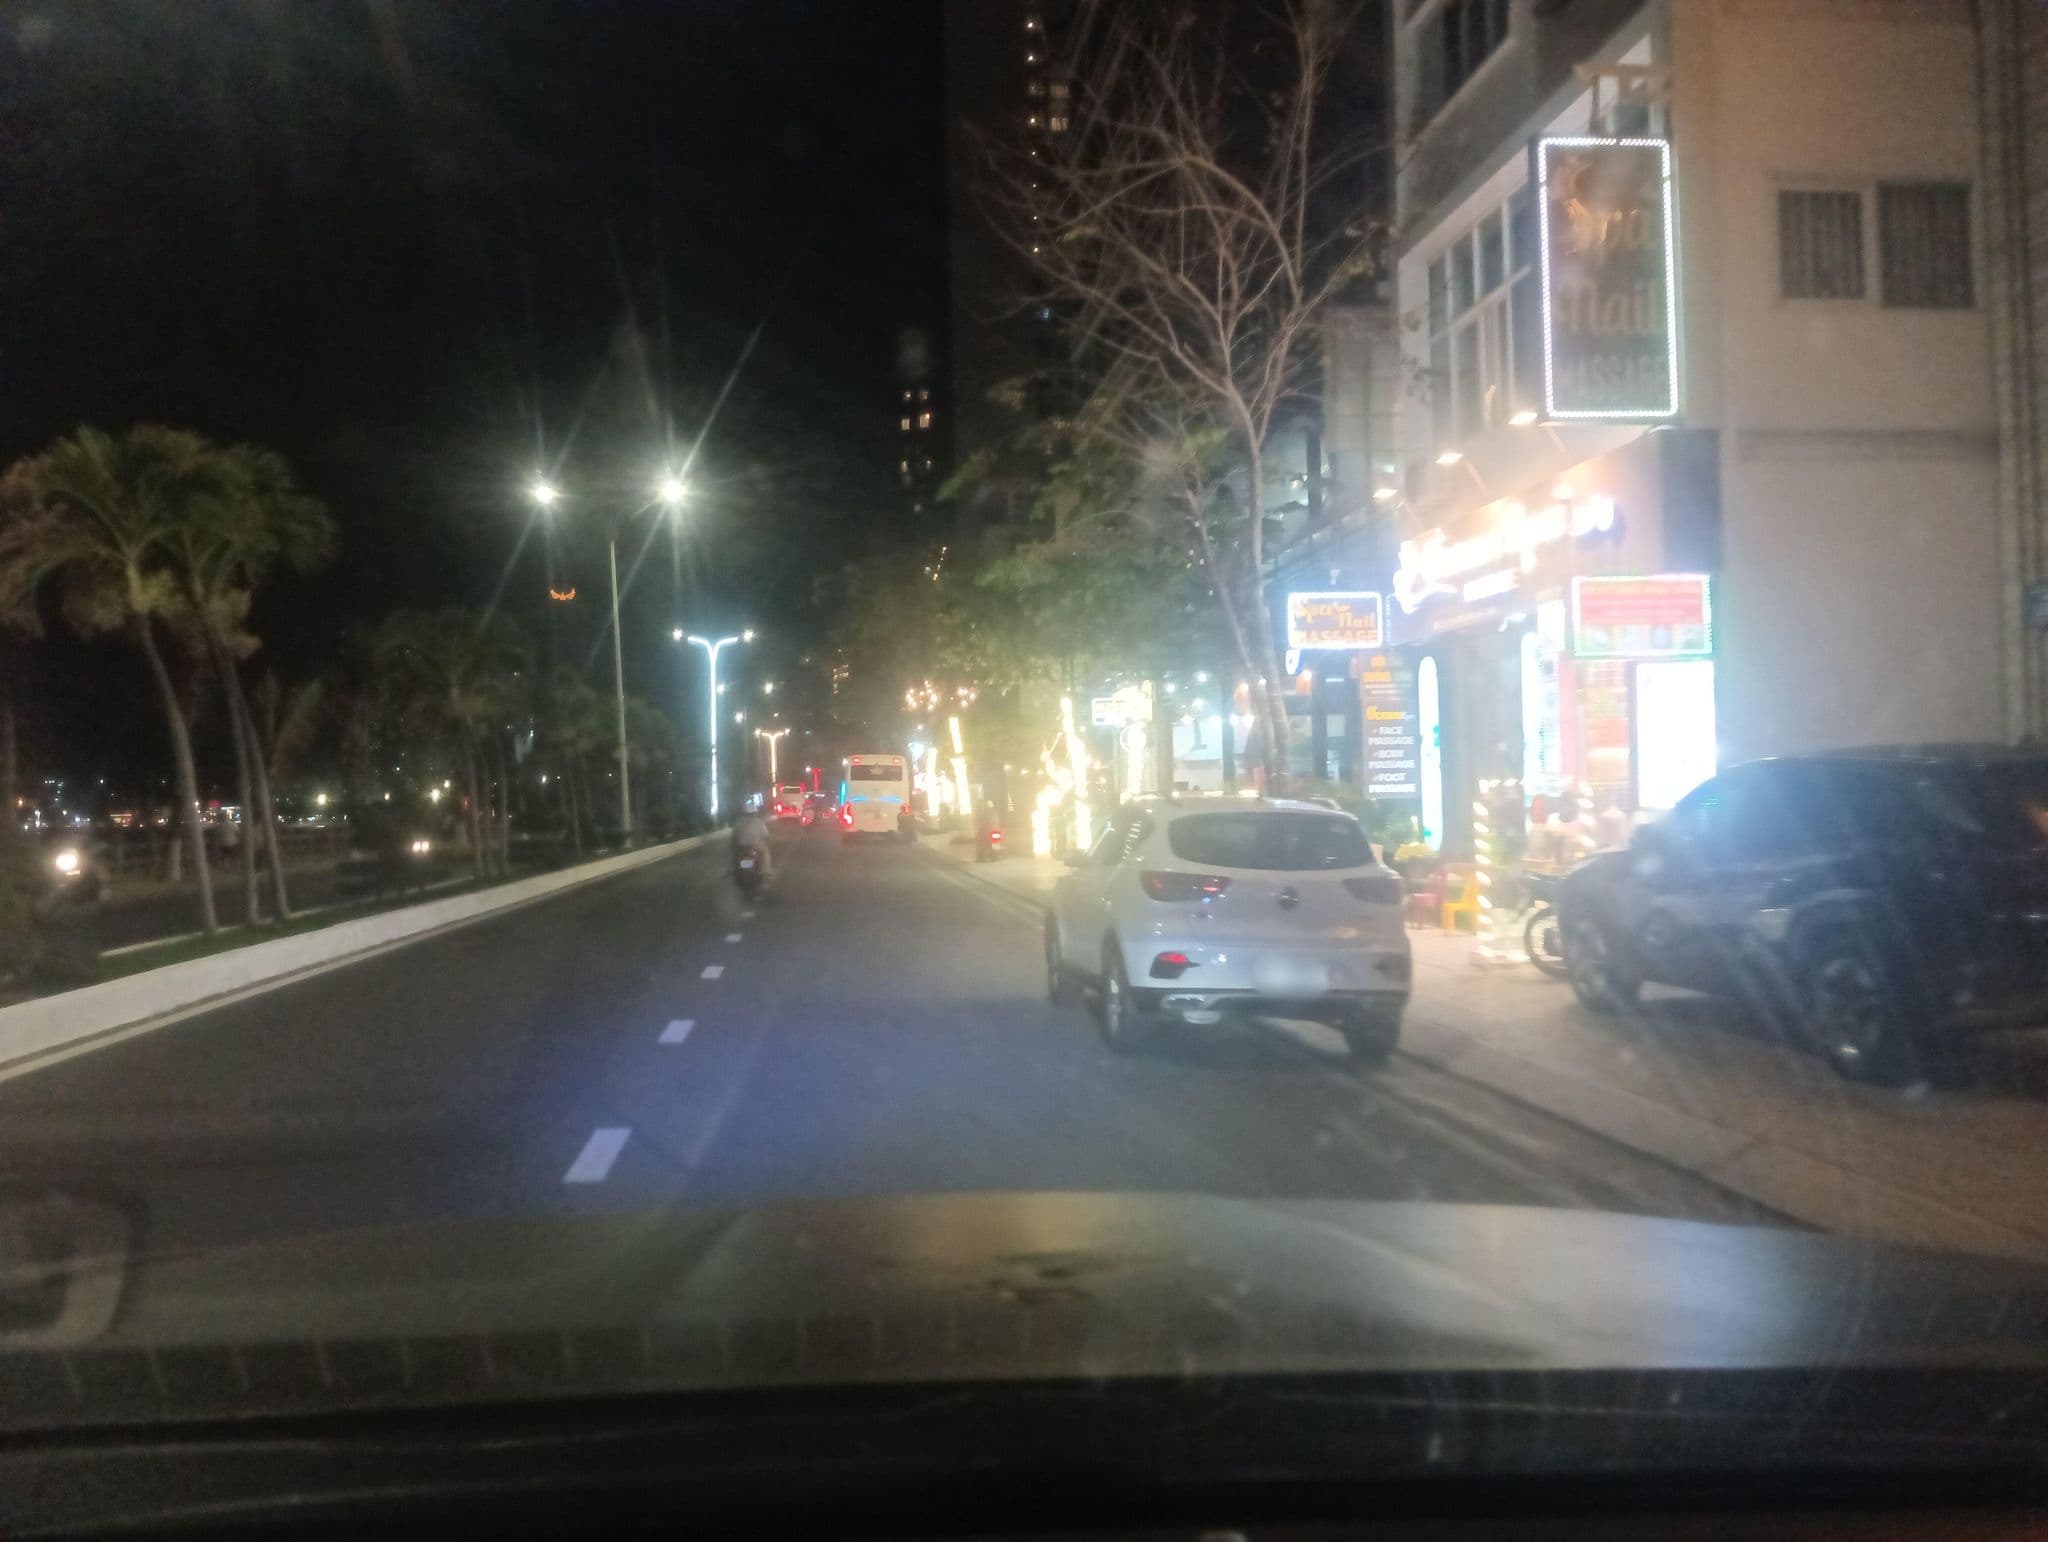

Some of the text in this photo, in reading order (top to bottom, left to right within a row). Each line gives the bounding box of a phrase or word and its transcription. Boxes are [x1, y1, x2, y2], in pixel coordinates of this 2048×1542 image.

[1295, 630, 1377, 642] MASSAGE
[1368, 736, 1416, 745] MASSAGE
[1368, 759, 1416, 769] MASSAGE
[1368, 783, 1416, 793] MASSAGE
